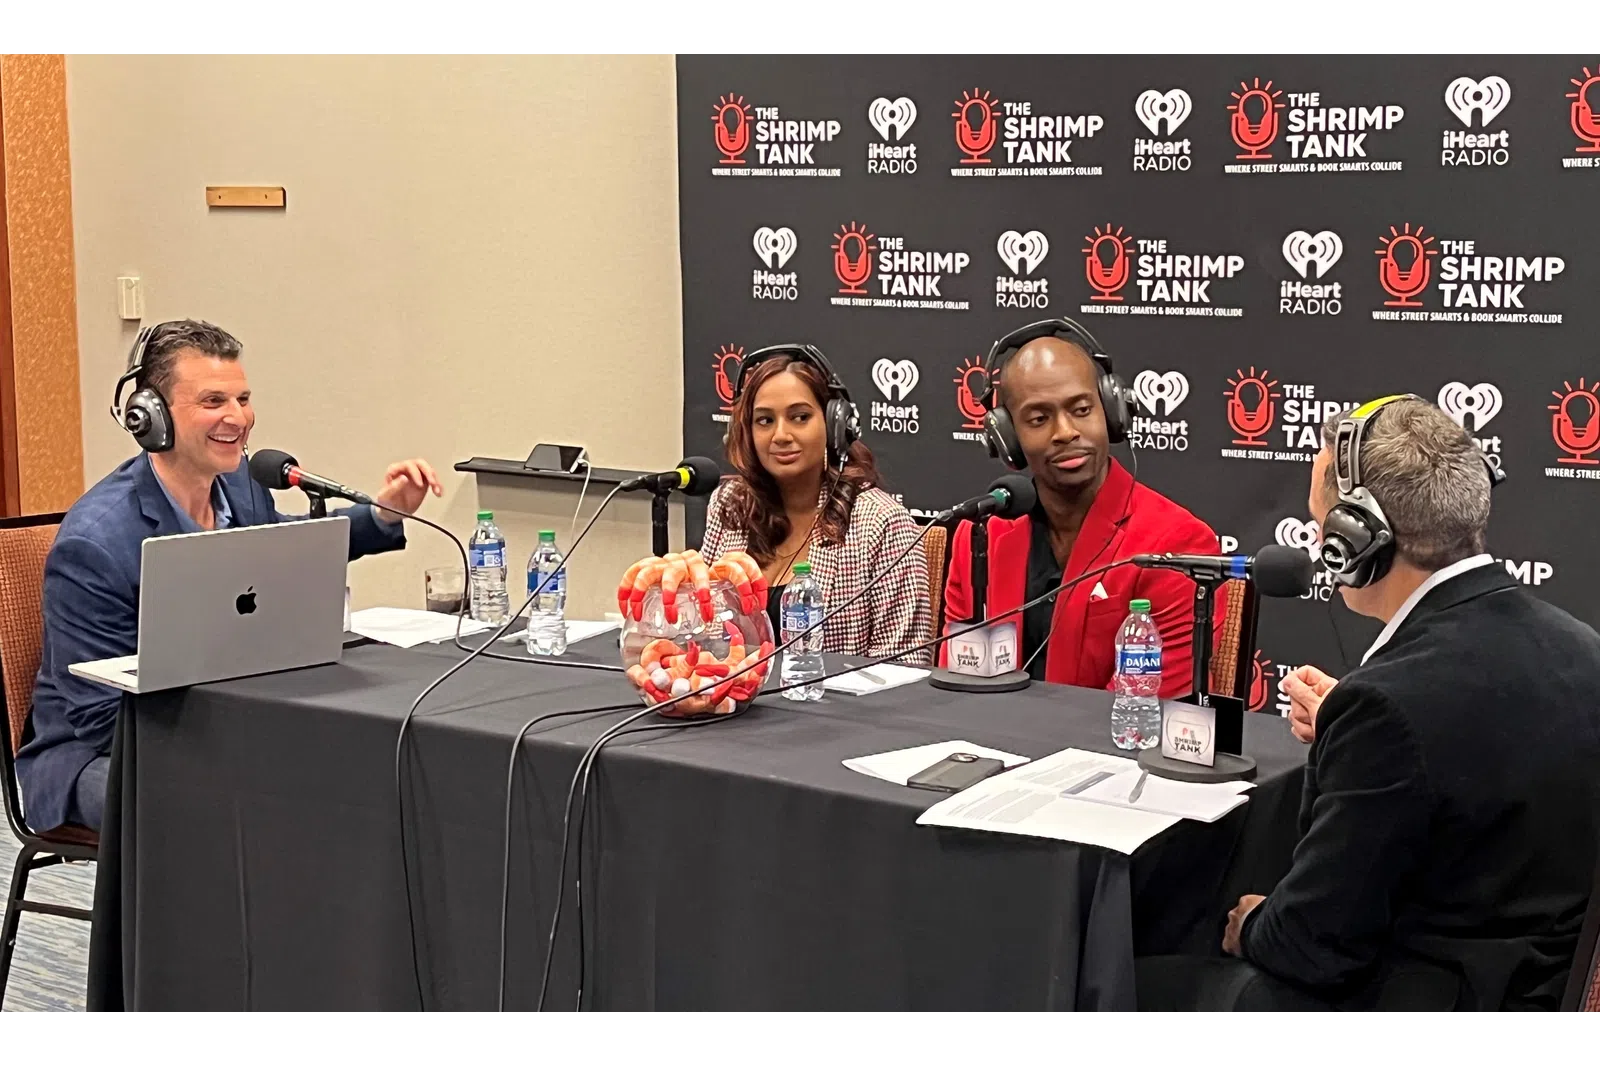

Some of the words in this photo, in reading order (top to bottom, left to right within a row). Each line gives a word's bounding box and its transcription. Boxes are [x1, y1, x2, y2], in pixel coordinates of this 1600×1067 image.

[1288, 93, 1319, 107] THE
[755, 107, 779, 119] THE
[1004, 102, 1031, 115] THE
[1288, 105, 1404, 132] SHRIMP
[756, 121, 841, 141] SHRIMP
[1004, 116, 1103, 139] SHRIMP
[1135, 138, 1191, 155] iHeart
[1286, 133, 1367, 158] TANK
[1443, 130, 1509, 148] iHeart
[756, 144, 814, 164] TANK
[869, 143, 916, 160] iHeart
[1003, 141, 1072, 163] TANK
[1442, 149, 1509, 166] RADIO
[868, 160, 917, 174] RADIO
[1134, 156, 1191, 171] RADIO
[1225, 165, 1251, 173] WHERE
[1252, 164, 1278, 173] STREET
[1279, 164, 1308, 172] SMARTS
[1318, 163, 1338, 172] BOOK
[1340, 162, 1370, 171] SMARTS
[1371, 162, 1402, 171] COLLIDE
[1563, 158, 1592, 167] WHERE
[974, 168, 996, 176] STREET
[998, 168, 1022, 176] SMARTS
[1030, 168, 1047, 176] BOOK
[1049, 167, 1075, 175] SMARTS
[1076, 167, 1102, 175] COLLIDE
[878, 238, 903, 250] THE
[1137, 240, 1166, 253] THE
[1440, 241, 1474, 255] THE
[878, 252, 969, 274] SHRIMP
[1138, 255, 1244, 277] SHRIMP
[1440, 256, 1565, 281] SHRIMP
[754, 270, 797, 286] iHeart
[878, 274, 941, 296] TANK
[997, 276, 1048, 294] iHeart
[753, 286, 798, 300] RADIO
[1137, 280, 1210, 302] TANK
[1281, 280, 1341, 298] iHeart
[1438, 284, 1525, 308] TANK
[852, 298, 872, 306] STREET
[873, 299, 896, 307] SMARTS
[903, 300, 919, 308] BOOK
[920, 301, 944, 309] SMARTS
[944, 301, 969, 309] COLLIDE
[996, 294, 1048, 308] RADIO
[1280, 299, 1341, 315] RADIO
[1081, 305, 1104, 313] WHERE
[1105, 306, 1129, 314] STREET
[1130, 306, 1157, 314] SMARTS
[1165, 307, 1184, 315] BOOK
[1186, 308, 1213, 316] SMARTS
[1214, 308, 1242, 316] COLLIDE
[1373, 311, 1399, 320] WHERE
[1401, 312, 1429, 321] STREET
[1430, 312, 1462, 321] SMARTS
[1471, 313, 1494, 322] BOOK
[1495, 313, 1528, 323] SMARTS
[1529, 314, 1562, 323] COLLIDE
[1283, 385, 1314, 398] THE
[871, 401, 918, 420] iHeart
[871, 419, 919, 433] RADIO
[1133, 416, 1188, 435] iHeart
[1132, 434, 1188, 451] RADIO
[1222, 449, 1246, 458] WHERE
[1248, 450, 1273, 459] STREET
[1275, 452, 1304, 461] SMARTS
[1545, 468, 1574, 477] WHERE
[1576, 470, 1600, 479] STREE
[1174, 742, 1202, 753] TANK
